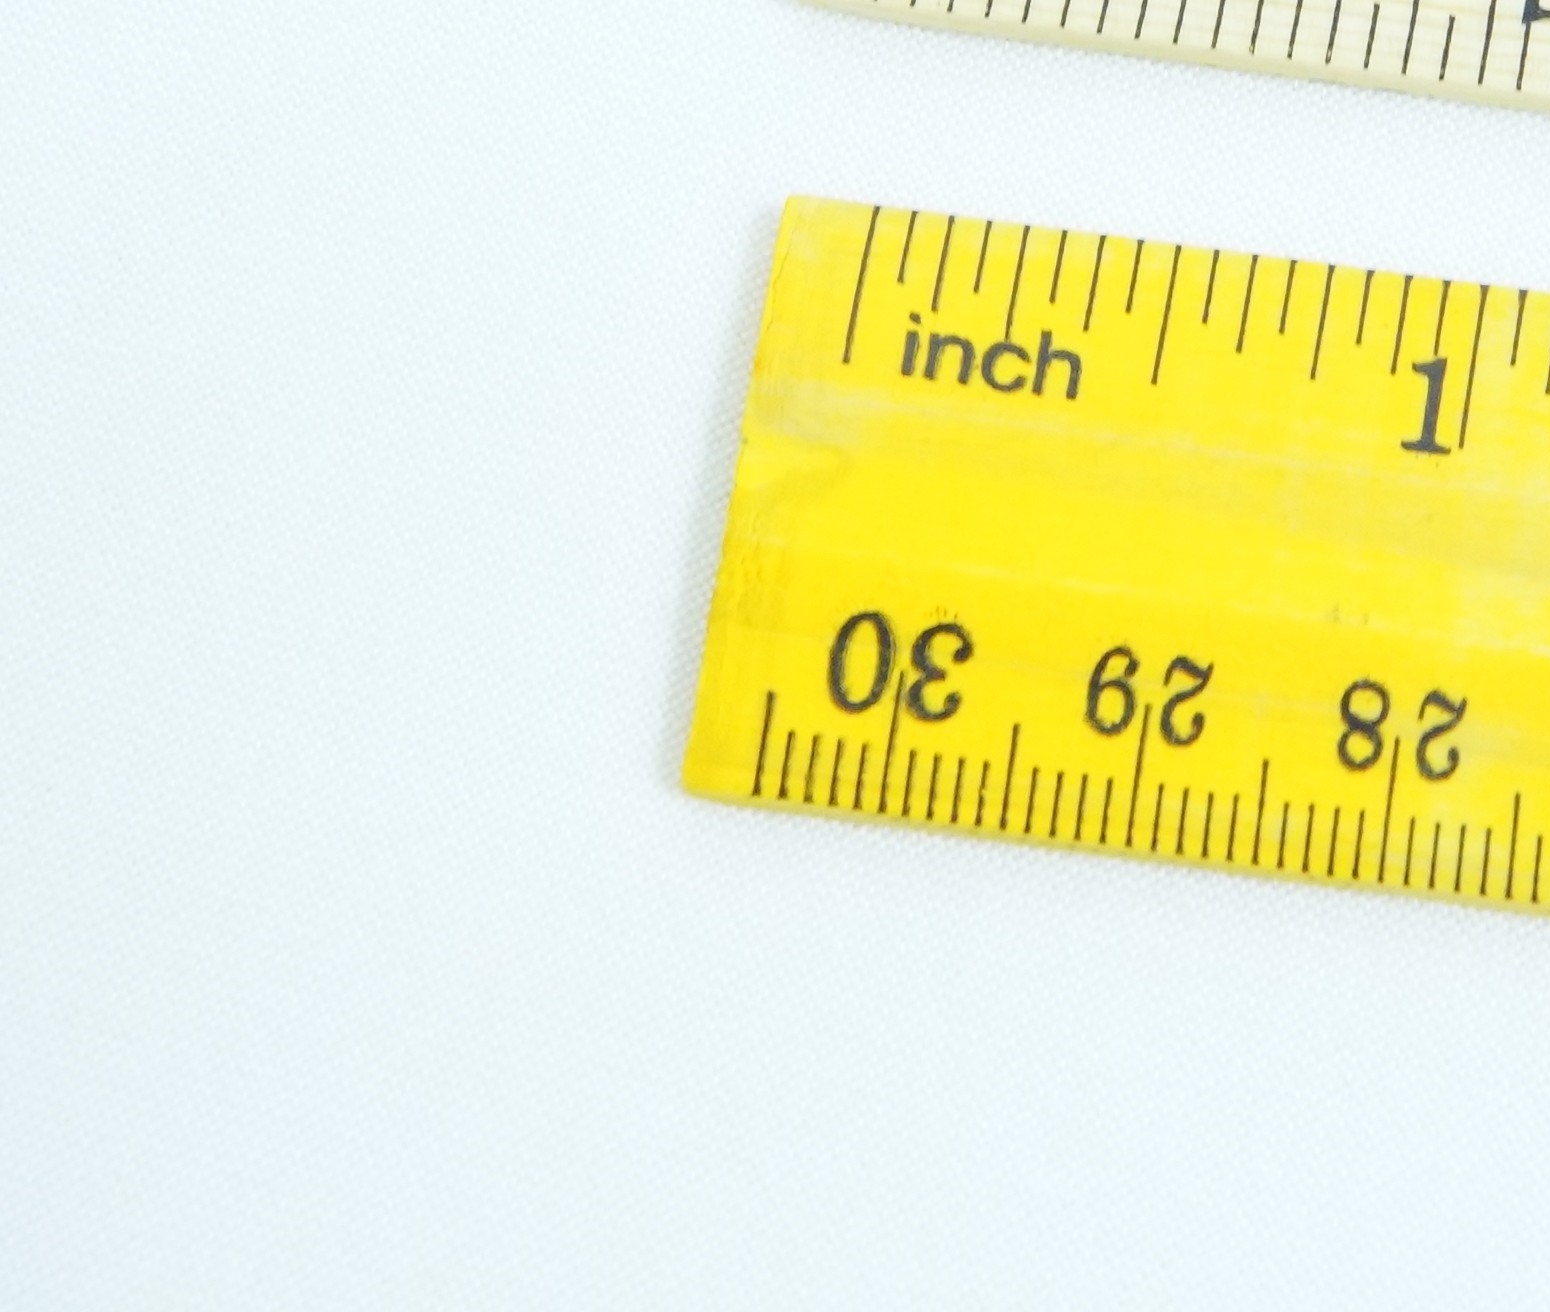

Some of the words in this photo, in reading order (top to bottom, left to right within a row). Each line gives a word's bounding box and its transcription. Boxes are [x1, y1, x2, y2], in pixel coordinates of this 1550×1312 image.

[901, 314, 1082, 400] inch
[1400, 357, 1454, 455] 1
[828, 610, 974, 723] 30
[1086, 645, 1215, 746] 29
[1339, 678, 1468, 780] 28
